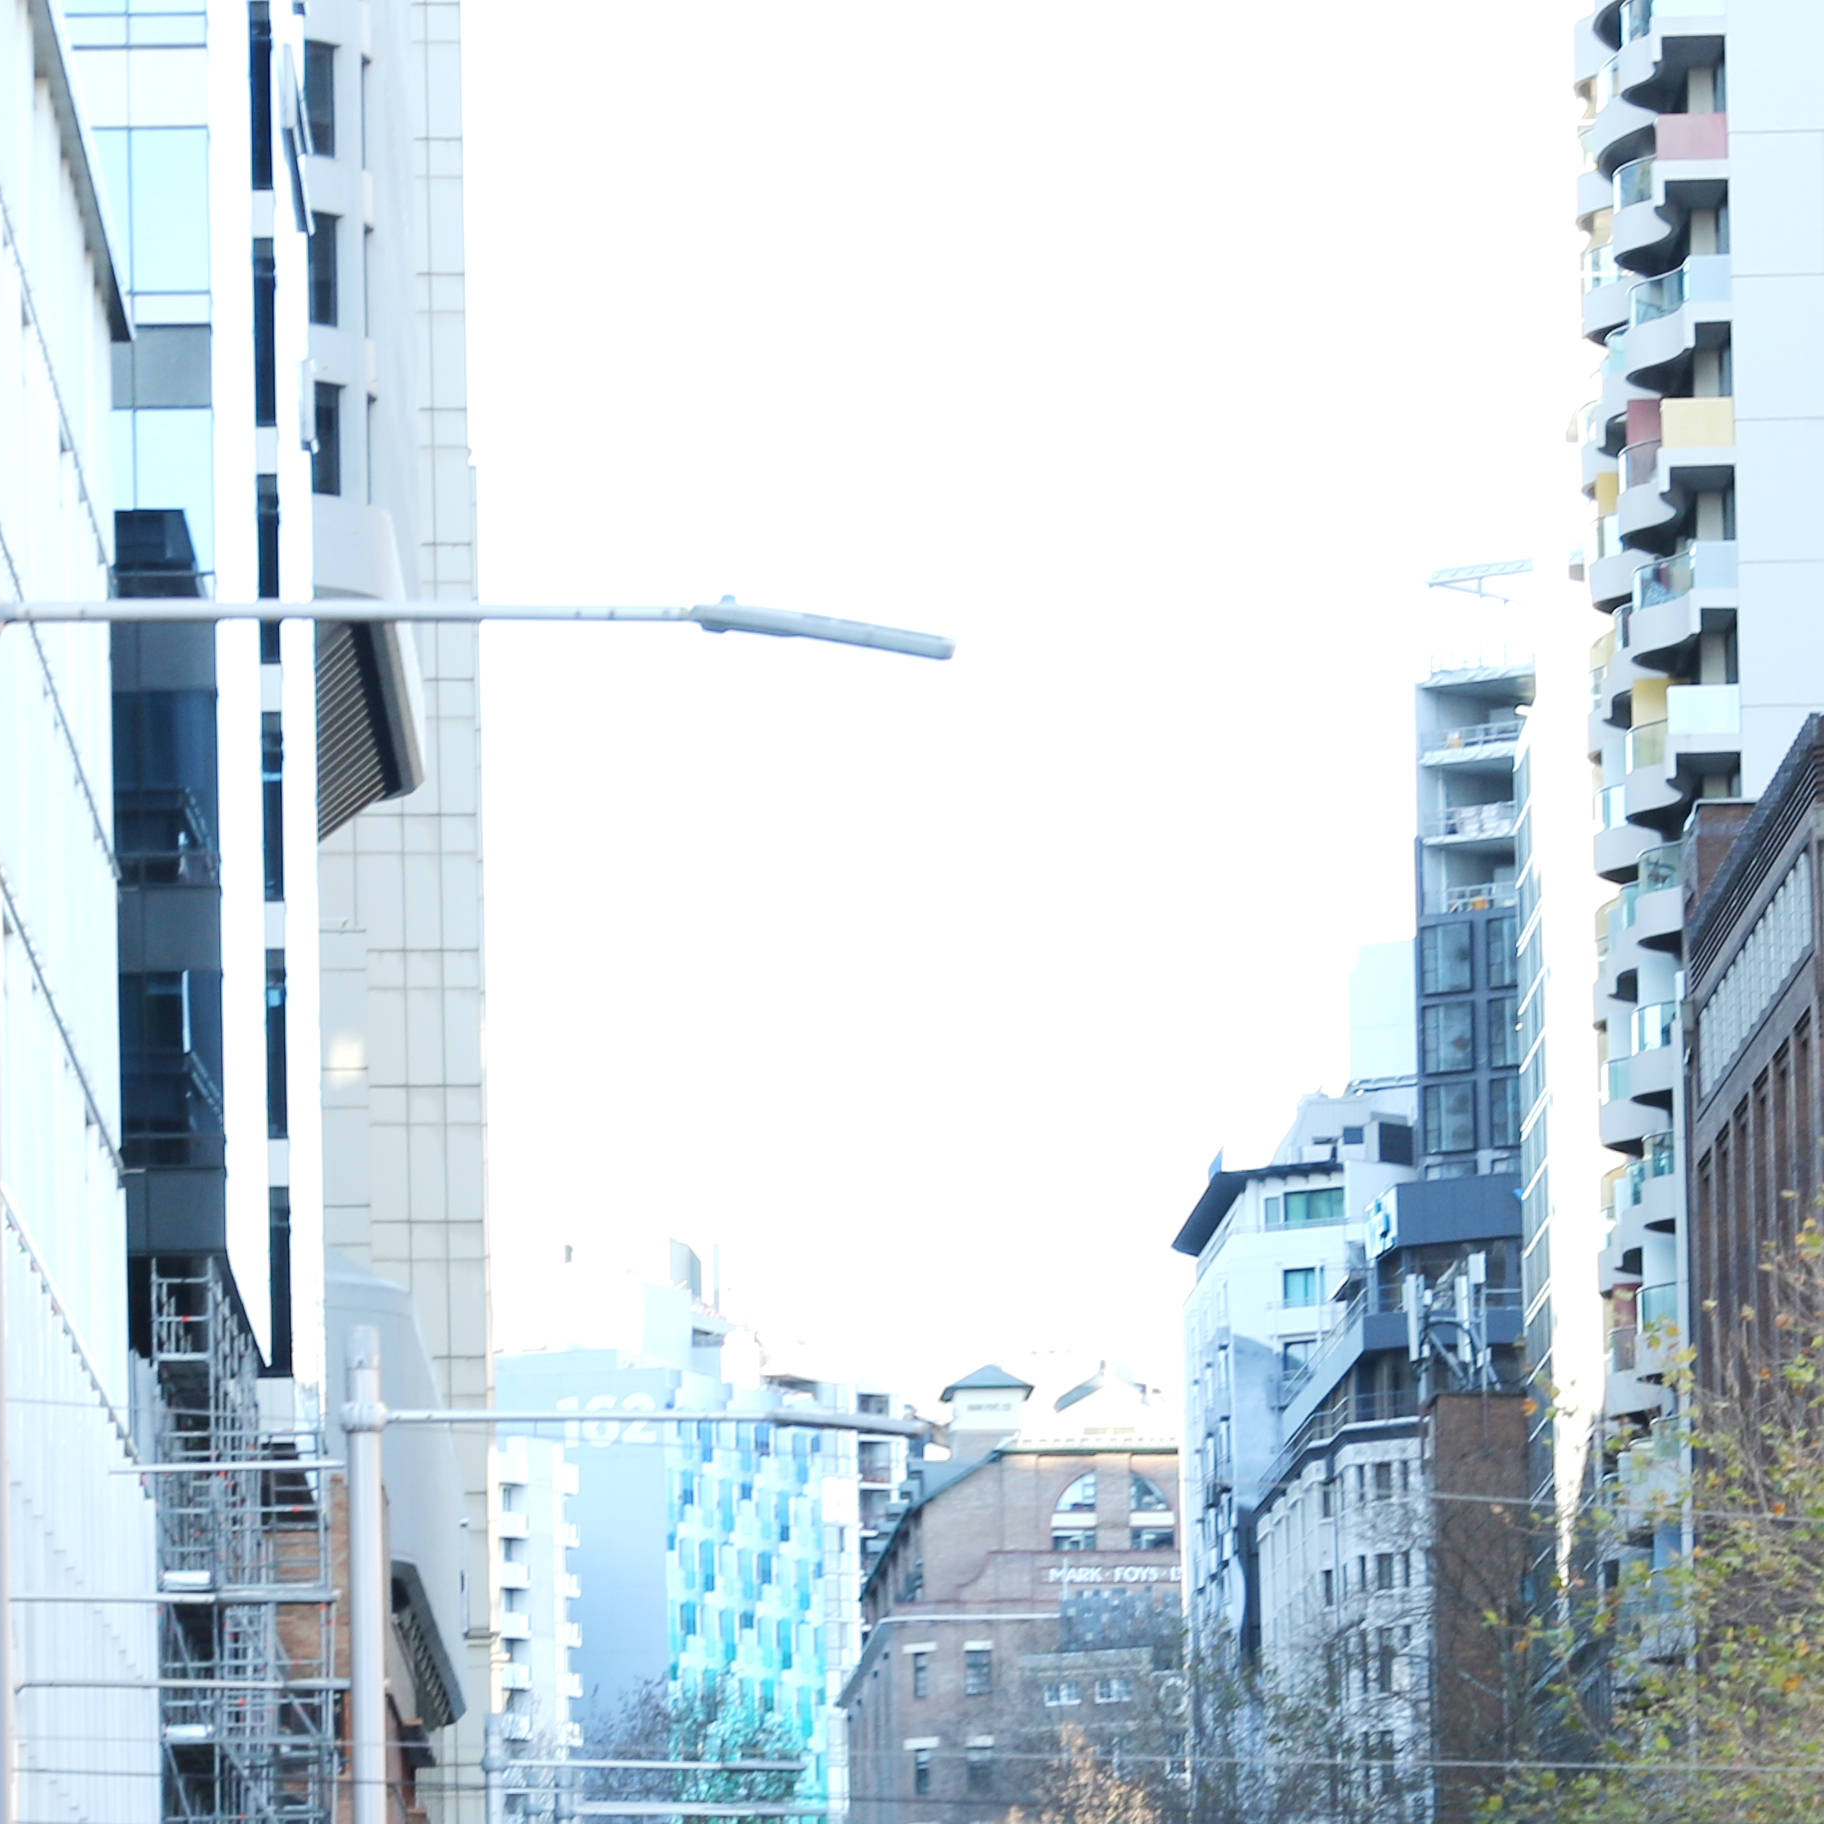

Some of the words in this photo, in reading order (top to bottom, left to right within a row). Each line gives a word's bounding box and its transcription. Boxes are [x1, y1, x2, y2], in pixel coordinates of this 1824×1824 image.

[555, 1391, 657, 1449] 162
[1048, 1566, 1103, 1583] MARK
[1112, 1565, 1159, 1583] FOYS
